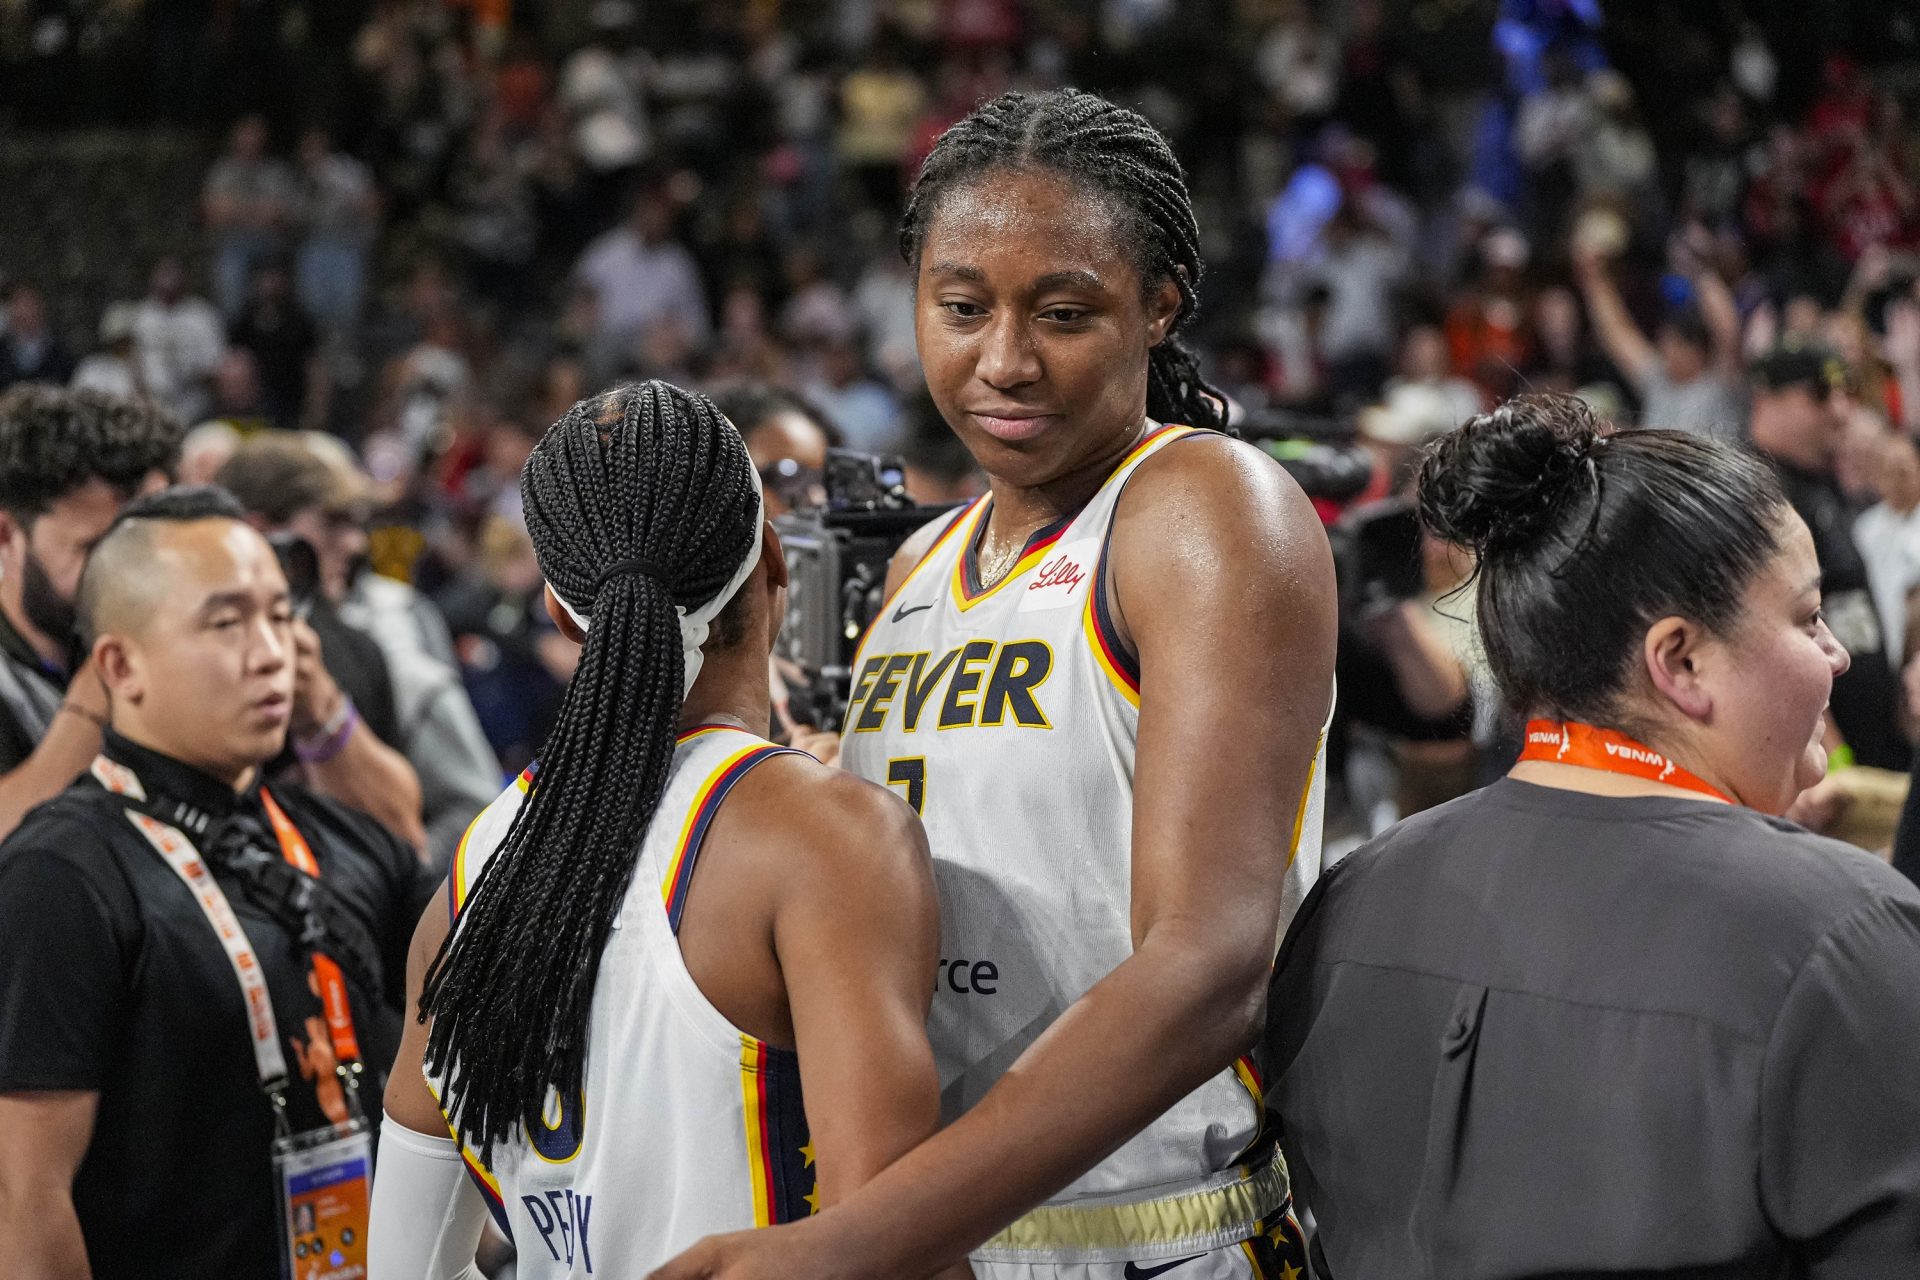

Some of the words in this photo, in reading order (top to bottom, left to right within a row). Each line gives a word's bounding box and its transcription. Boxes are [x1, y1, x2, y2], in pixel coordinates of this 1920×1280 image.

[1029, 554, 1085, 594] Lilly
[841, 638, 1054, 733] FEVER
[1528, 731, 1560, 745] WNBA
[1604, 741, 1664, 766] WNBA
